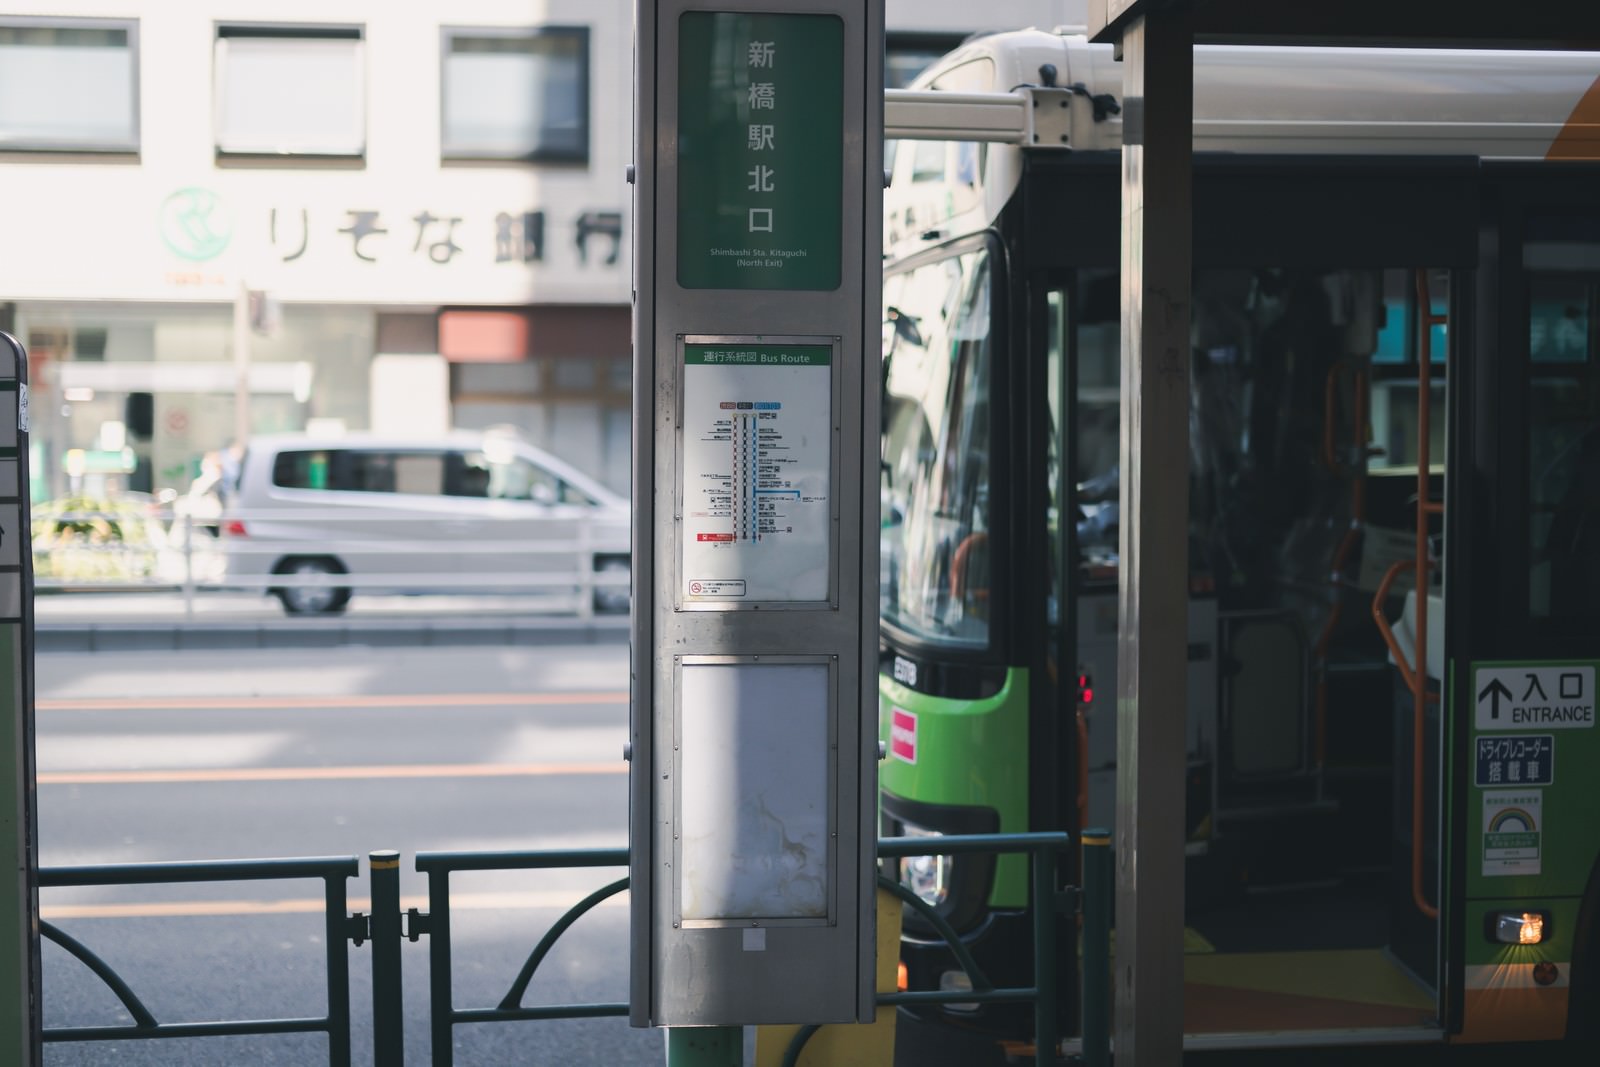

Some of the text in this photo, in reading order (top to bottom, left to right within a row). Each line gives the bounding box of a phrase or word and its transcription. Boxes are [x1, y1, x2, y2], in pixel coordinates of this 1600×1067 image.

[748, 41, 775, 232] 新橋駅北口
[270, 207, 622, 265] りそな銀行
[710, 248, 807, 258] Shimbashi Sta. Kitaguchi
[736, 259, 784, 268] (North Exit)
[704, 351, 810, 363] 運行系統図 Bus Route
[1521, 673, 1583, 702] 入口
[1512, 705, 1592, 723] ENTRANCE
[1480, 739, 1550, 760] ドライブレコーダー
[1488, 761, 1540, 782] 搭載車
